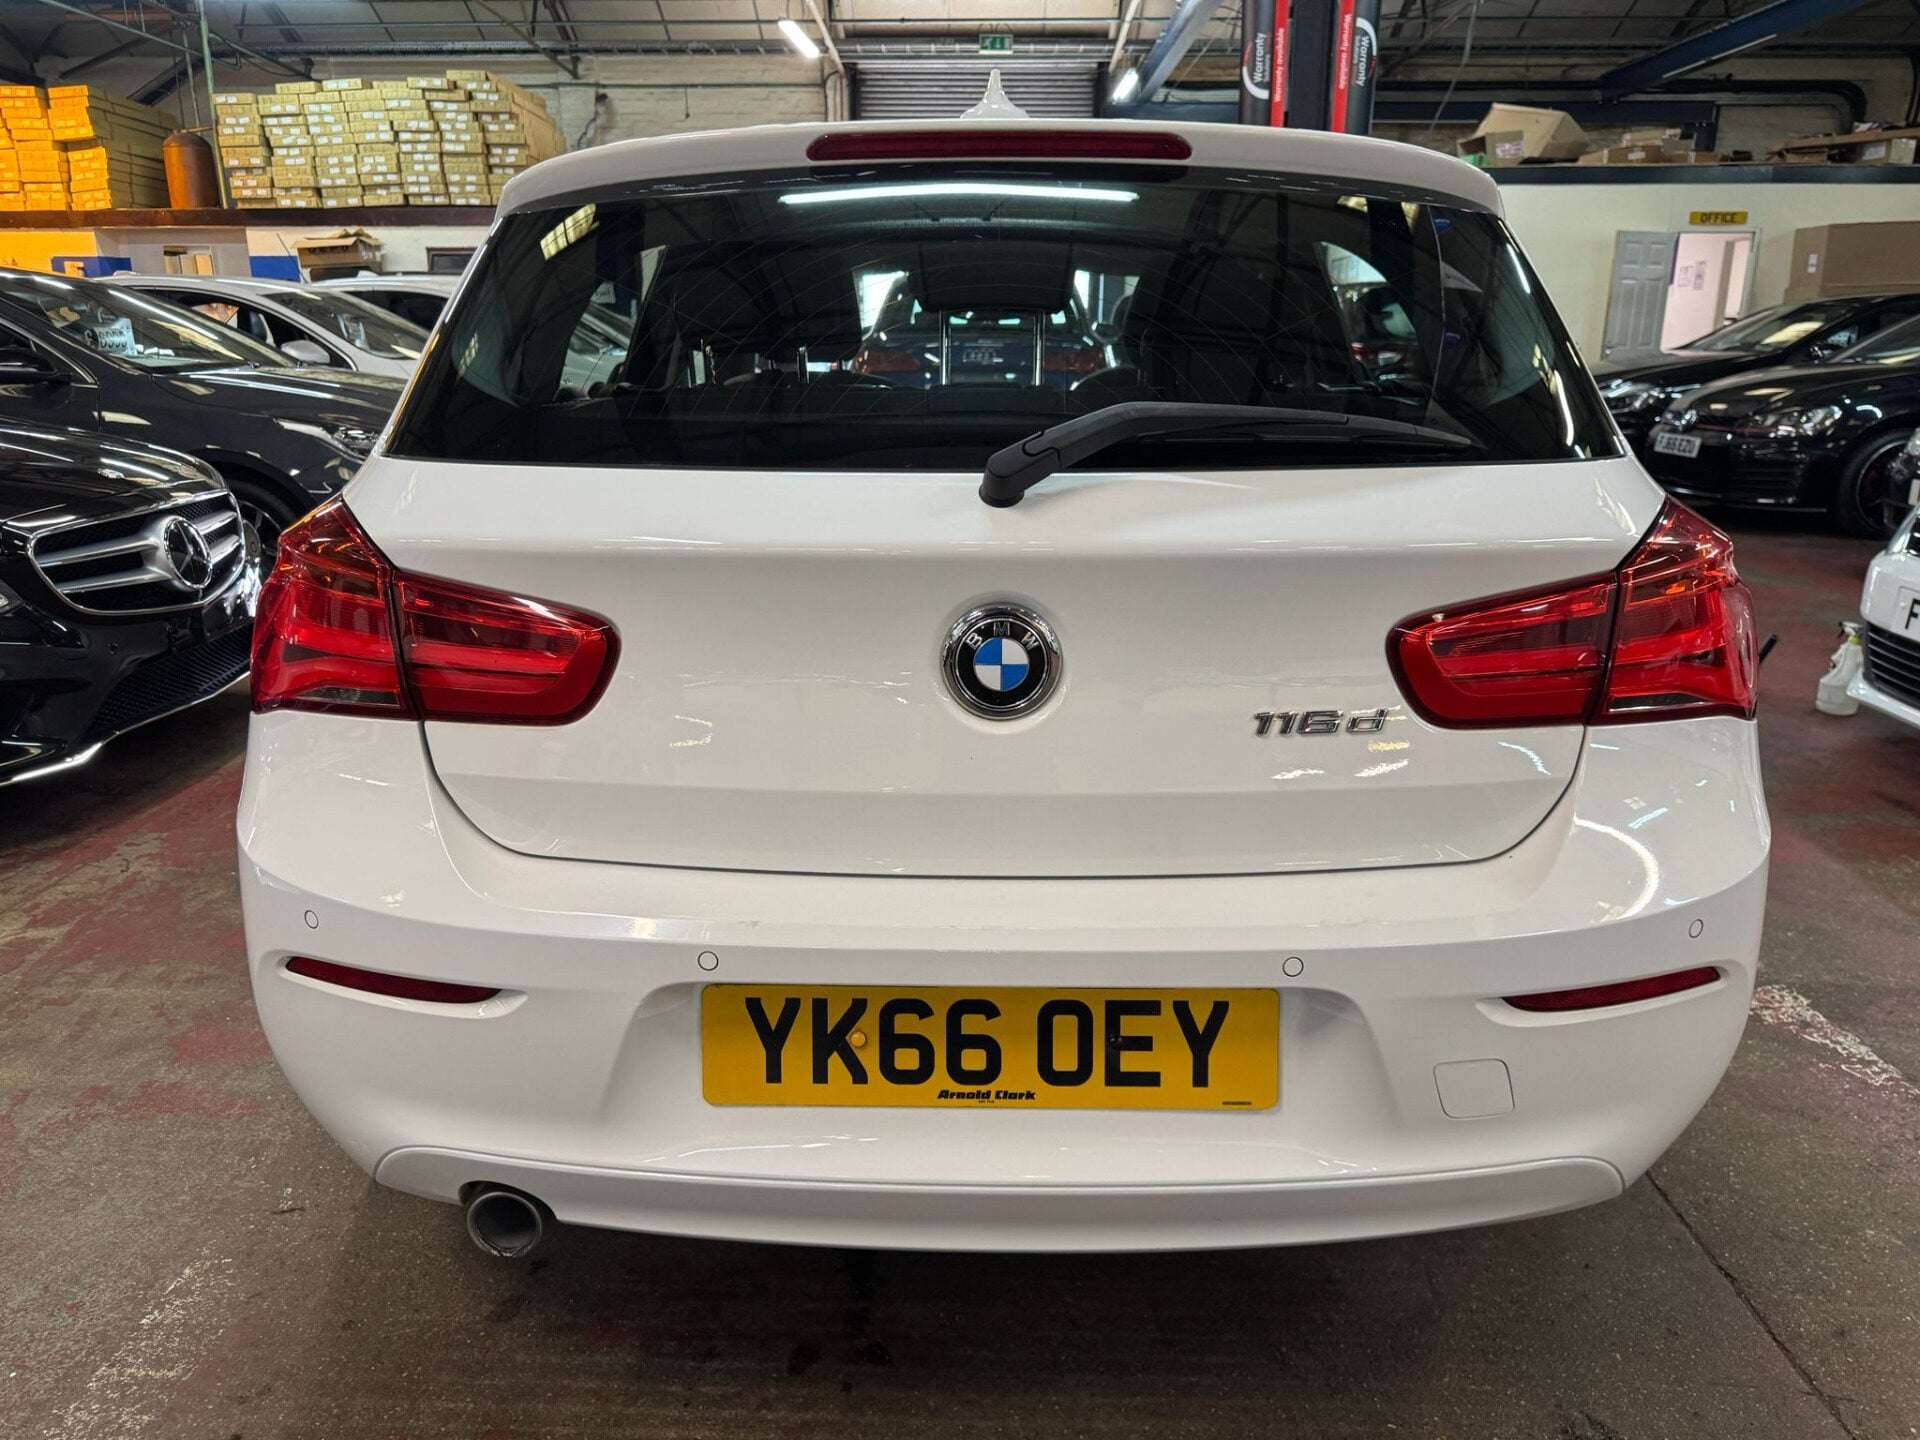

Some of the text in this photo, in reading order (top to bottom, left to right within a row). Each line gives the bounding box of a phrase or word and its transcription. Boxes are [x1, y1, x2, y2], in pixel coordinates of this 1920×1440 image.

[1253, 32, 1267, 83] Warranty
[1274, 28, 1285, 102] Warranty available
[1338, 13, 1352, 89] Warranty available
[1356, 35, 1370, 87] Warranty
[1699, 211, 1738, 224] OFFICE
[966, 621, 1040, 650] BMW
[1254, 708, 1388, 735] 116d
[745, 997, 1230, 1088] YK66 OEY
[938, 1089, 1036, 1101] Arnold Clark
